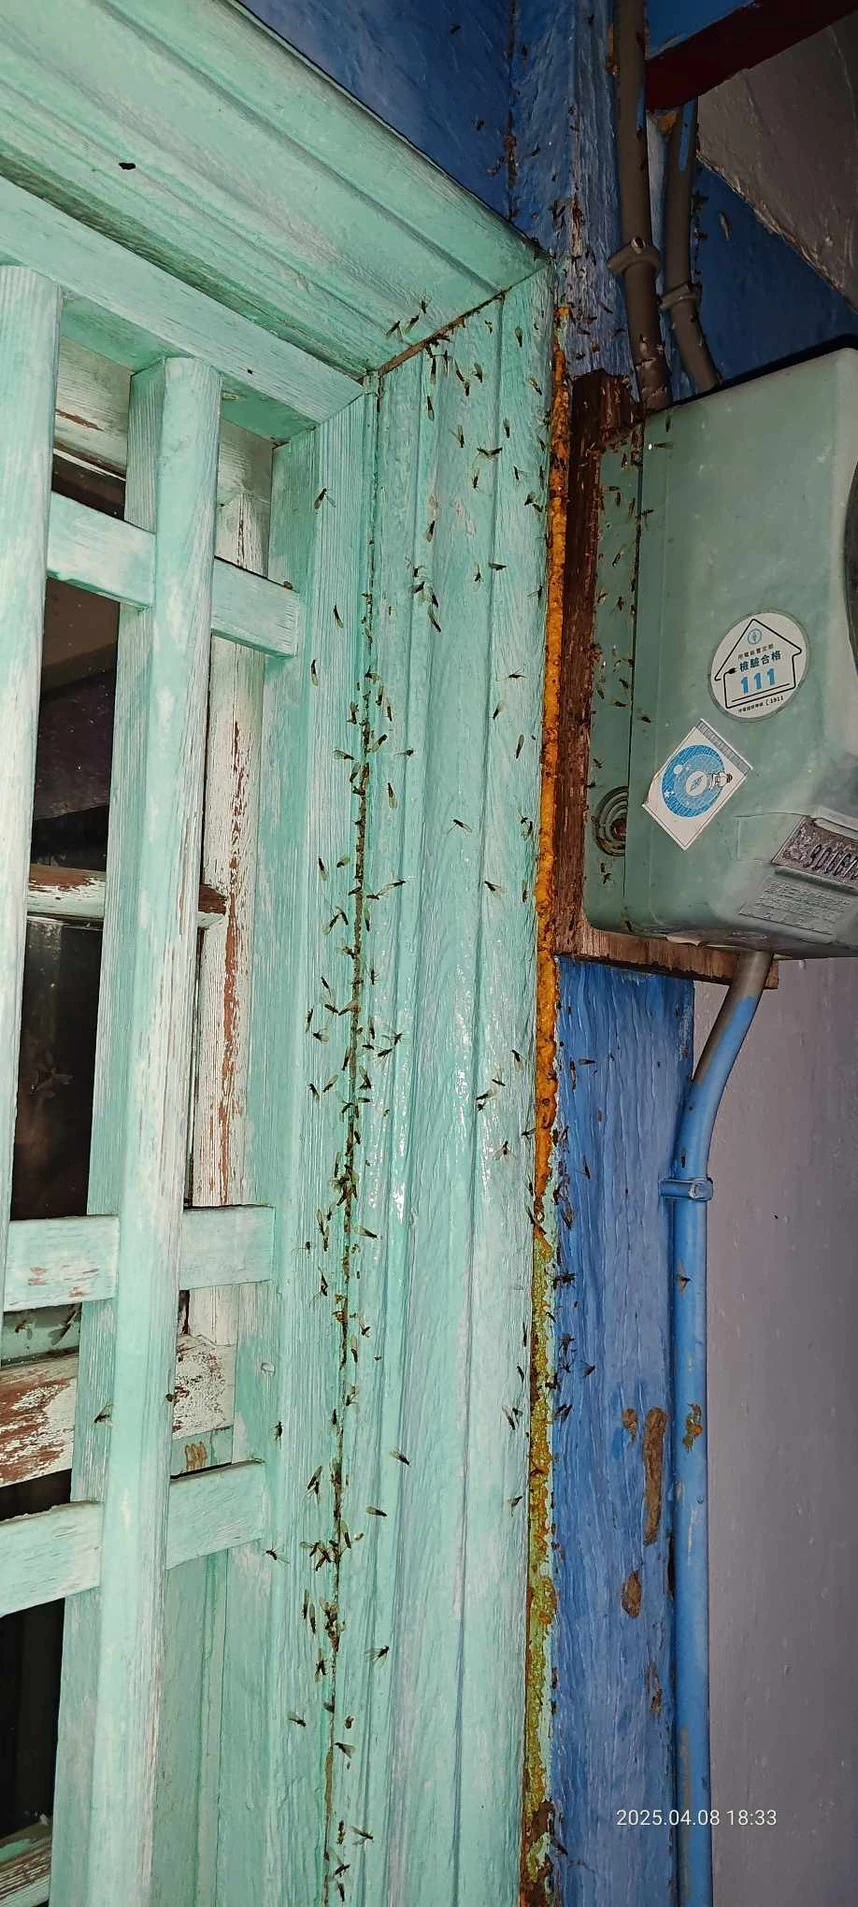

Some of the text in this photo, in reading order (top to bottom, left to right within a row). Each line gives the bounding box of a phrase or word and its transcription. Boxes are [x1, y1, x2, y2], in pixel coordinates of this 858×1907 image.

[740, 650, 781, 672] 檢驗合格
[741, 668, 775, 694] 111
